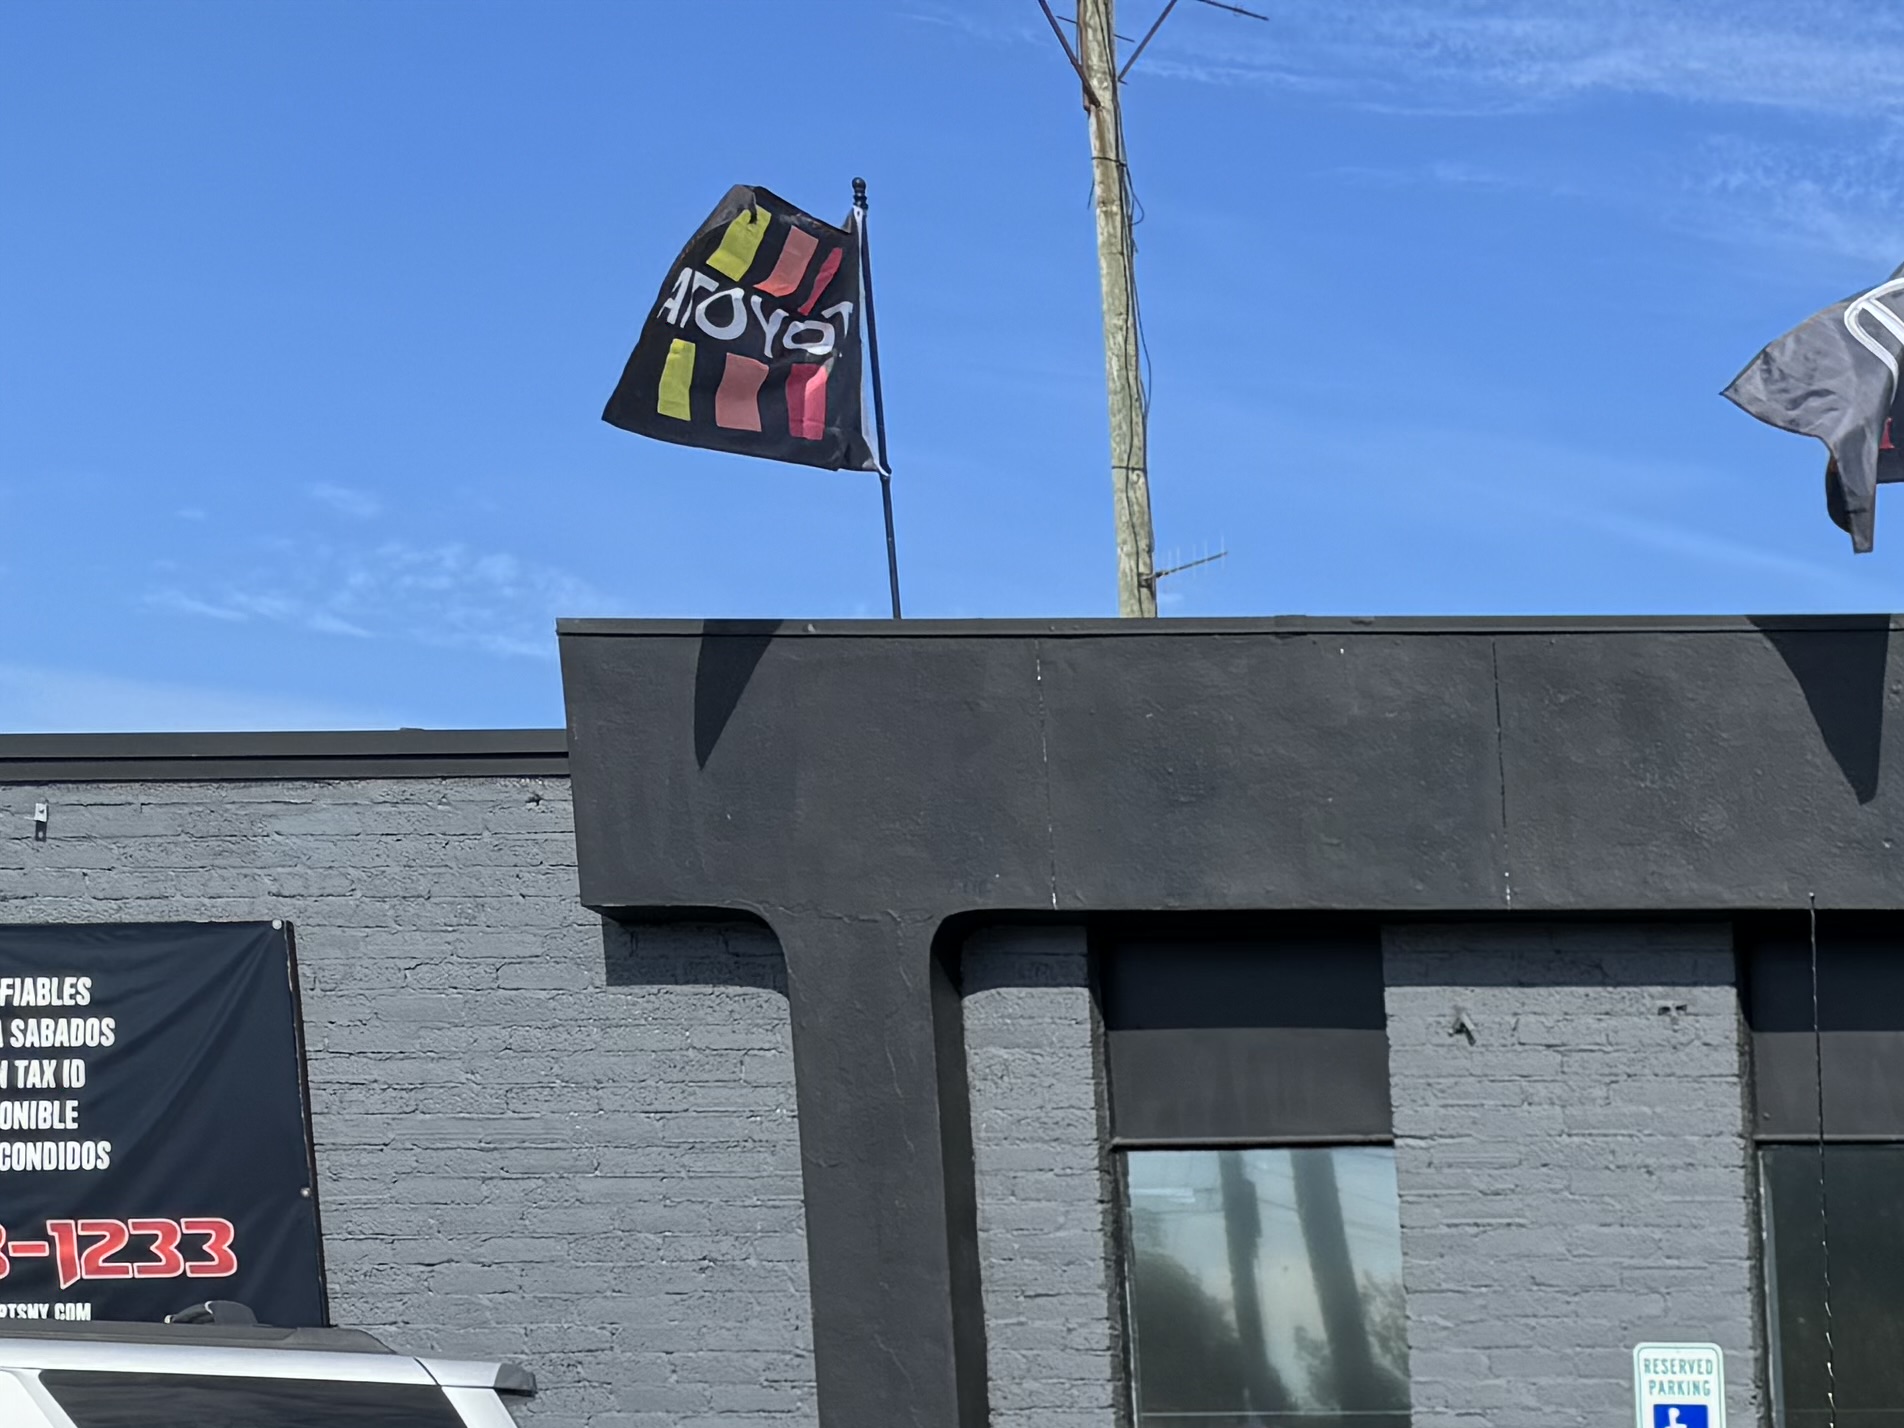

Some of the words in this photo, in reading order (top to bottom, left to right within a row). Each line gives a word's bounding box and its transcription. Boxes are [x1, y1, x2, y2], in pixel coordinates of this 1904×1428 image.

[9, 1017, 116, 1048] SABADOS
[14, 1058, 57, 1089] TAX
[62, 1058, 86, 1088] ID
[0, 1217, 238, 1290] -1233
[1643, 1358, 1714, 1375] RESERVED
[1648, 1380, 1711, 1397] PARKING
